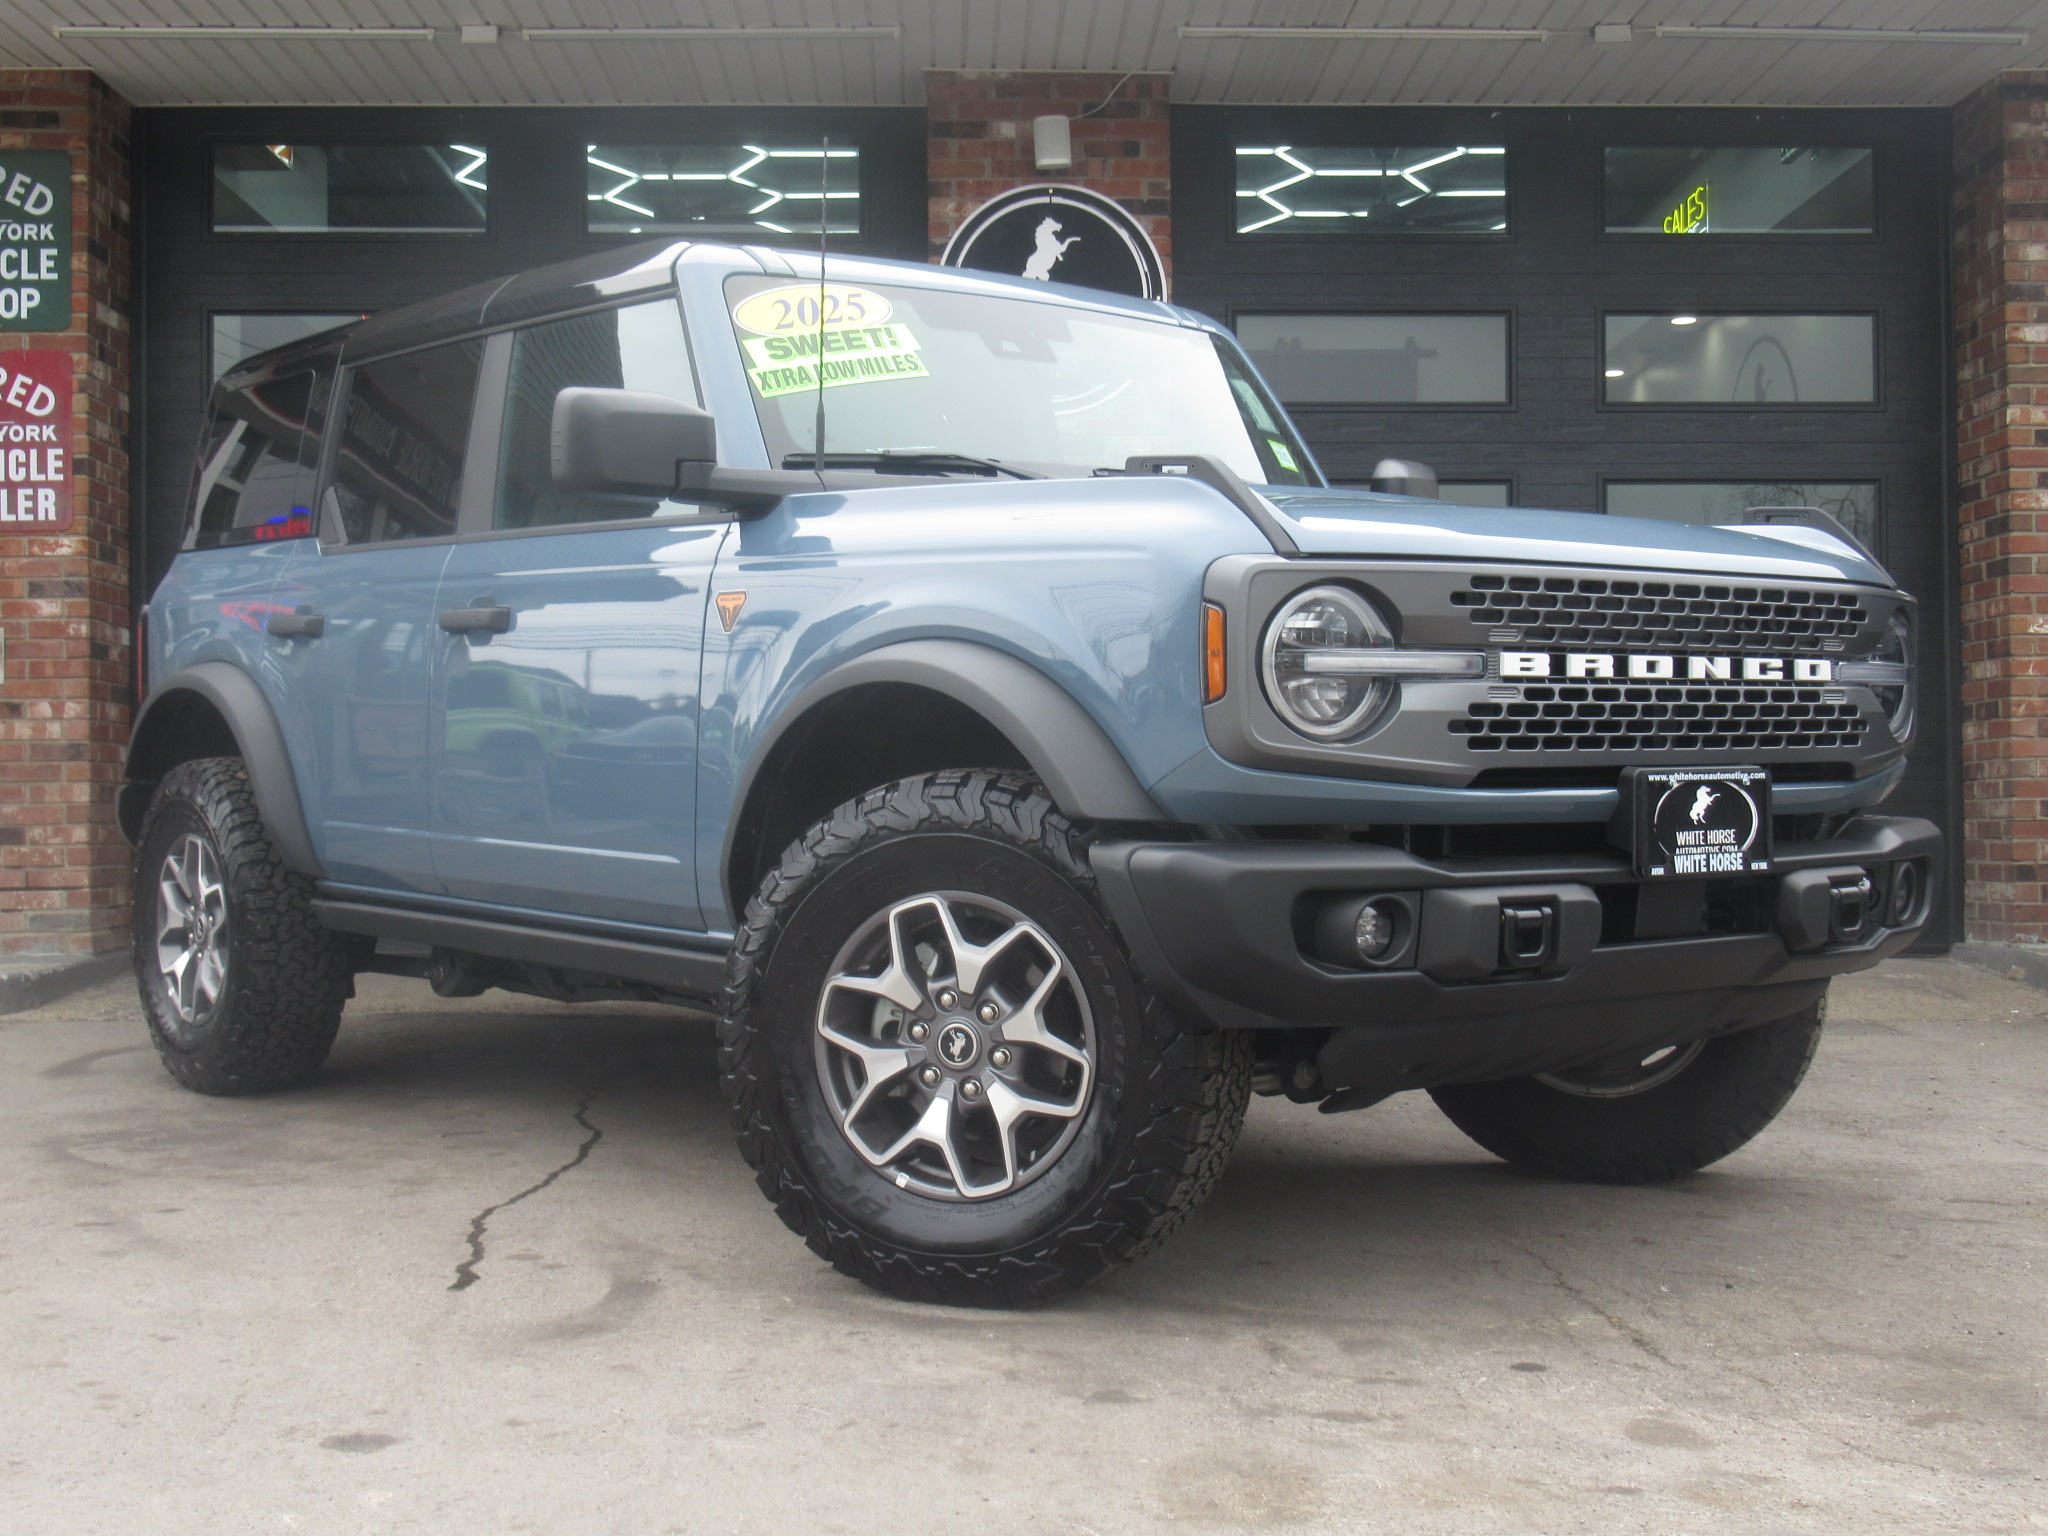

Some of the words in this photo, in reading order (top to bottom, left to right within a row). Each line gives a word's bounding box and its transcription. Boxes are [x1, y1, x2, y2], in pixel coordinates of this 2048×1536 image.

[0, 248, 59, 280] CLE
[0, 287, 41, 319] OP
[771, 293, 866, 330] 2025
[764, 327, 898, 361] SWEET!
[756, 364, 813, 392] XTRA
[813, 359, 857, 384] LOW
[858, 354, 920, 377] MILES
[0, 487, 57, 522] LER
[1499, 651, 1832, 681] BRONCO
[1648, 772, 1766, 781] www.whitehorseautomotive.com
[1676, 830, 1705, 846] WHITE
[1707, 829, 1736, 845] HORSE
[1674, 854, 1708, 874] WHITE
[1709, 852, 1744, 872] HORSE
